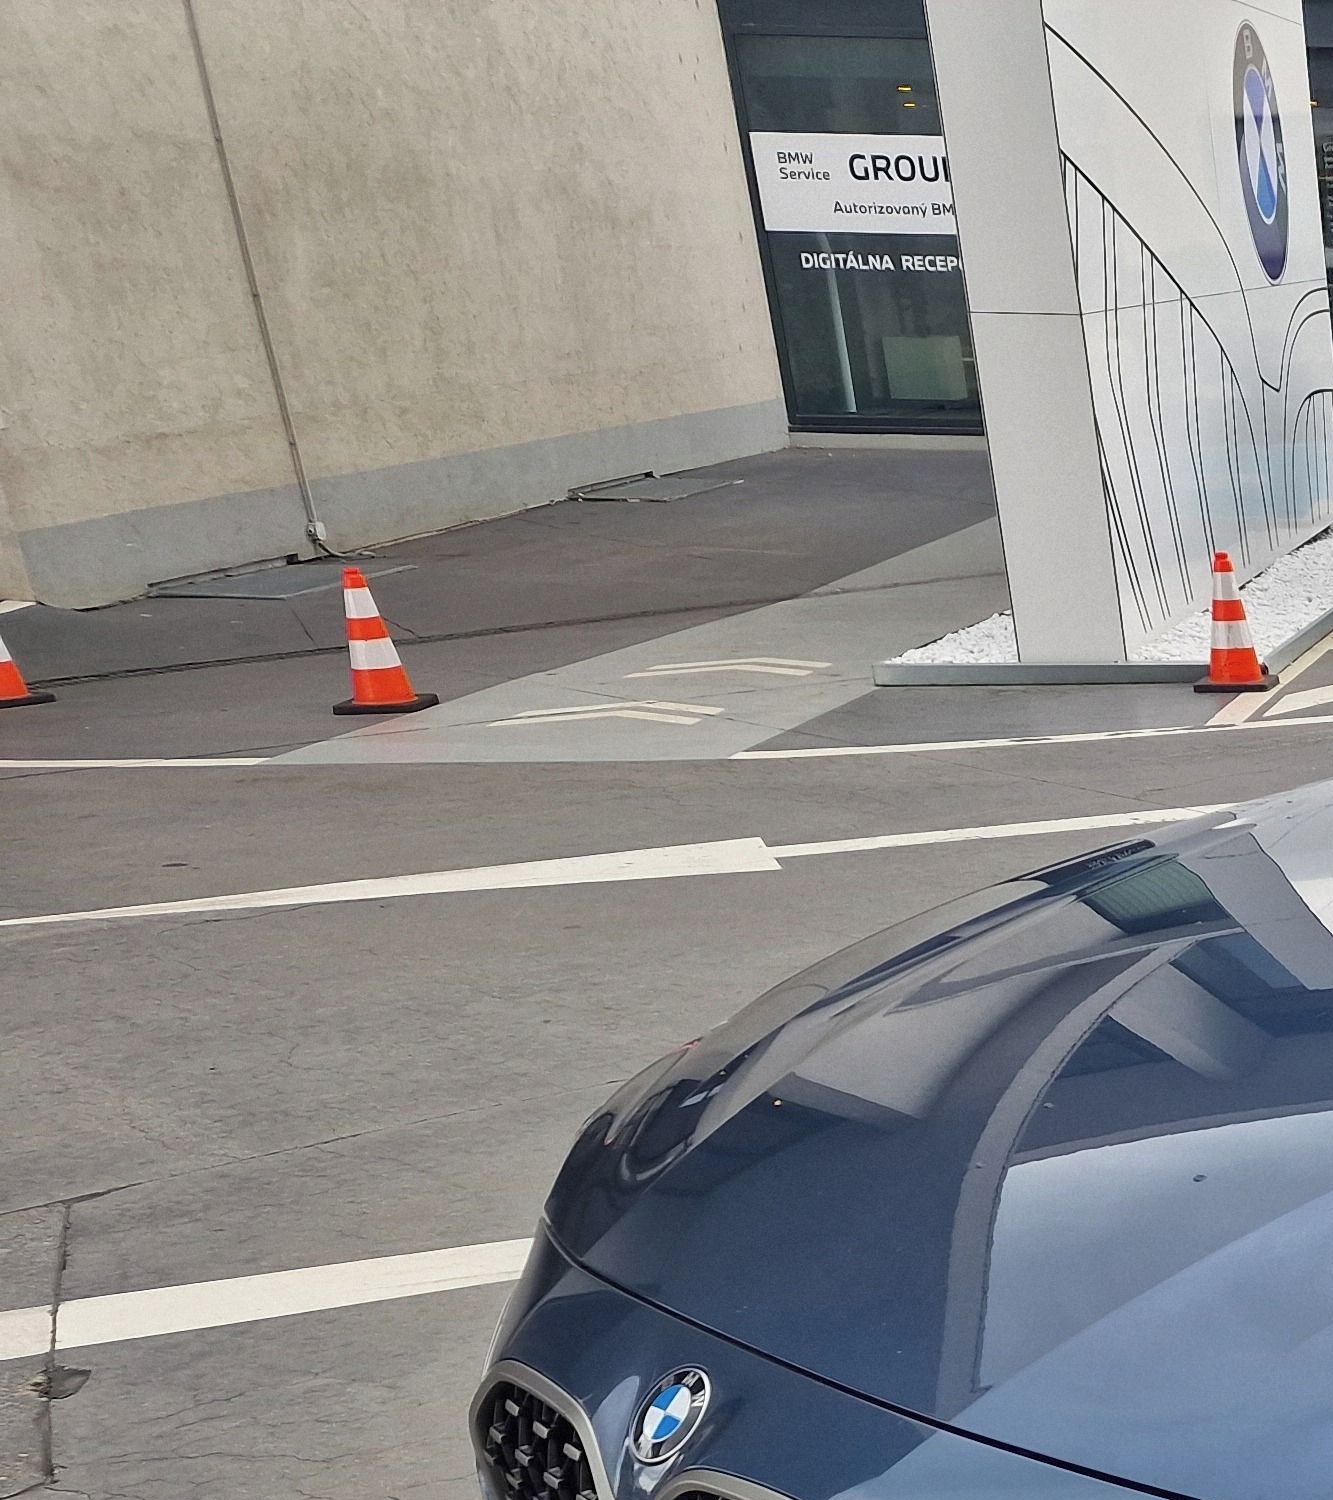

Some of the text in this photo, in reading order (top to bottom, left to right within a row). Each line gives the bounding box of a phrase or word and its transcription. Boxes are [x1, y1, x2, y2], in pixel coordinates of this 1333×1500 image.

[777, 152, 813, 165] BMW
[779, 167, 831, 181] Service
[849, 154, 950, 182] GROU
[833, 201, 927, 218] Autorizovaný
[801, 251, 963, 272] DIGITÁLNA RECEP
